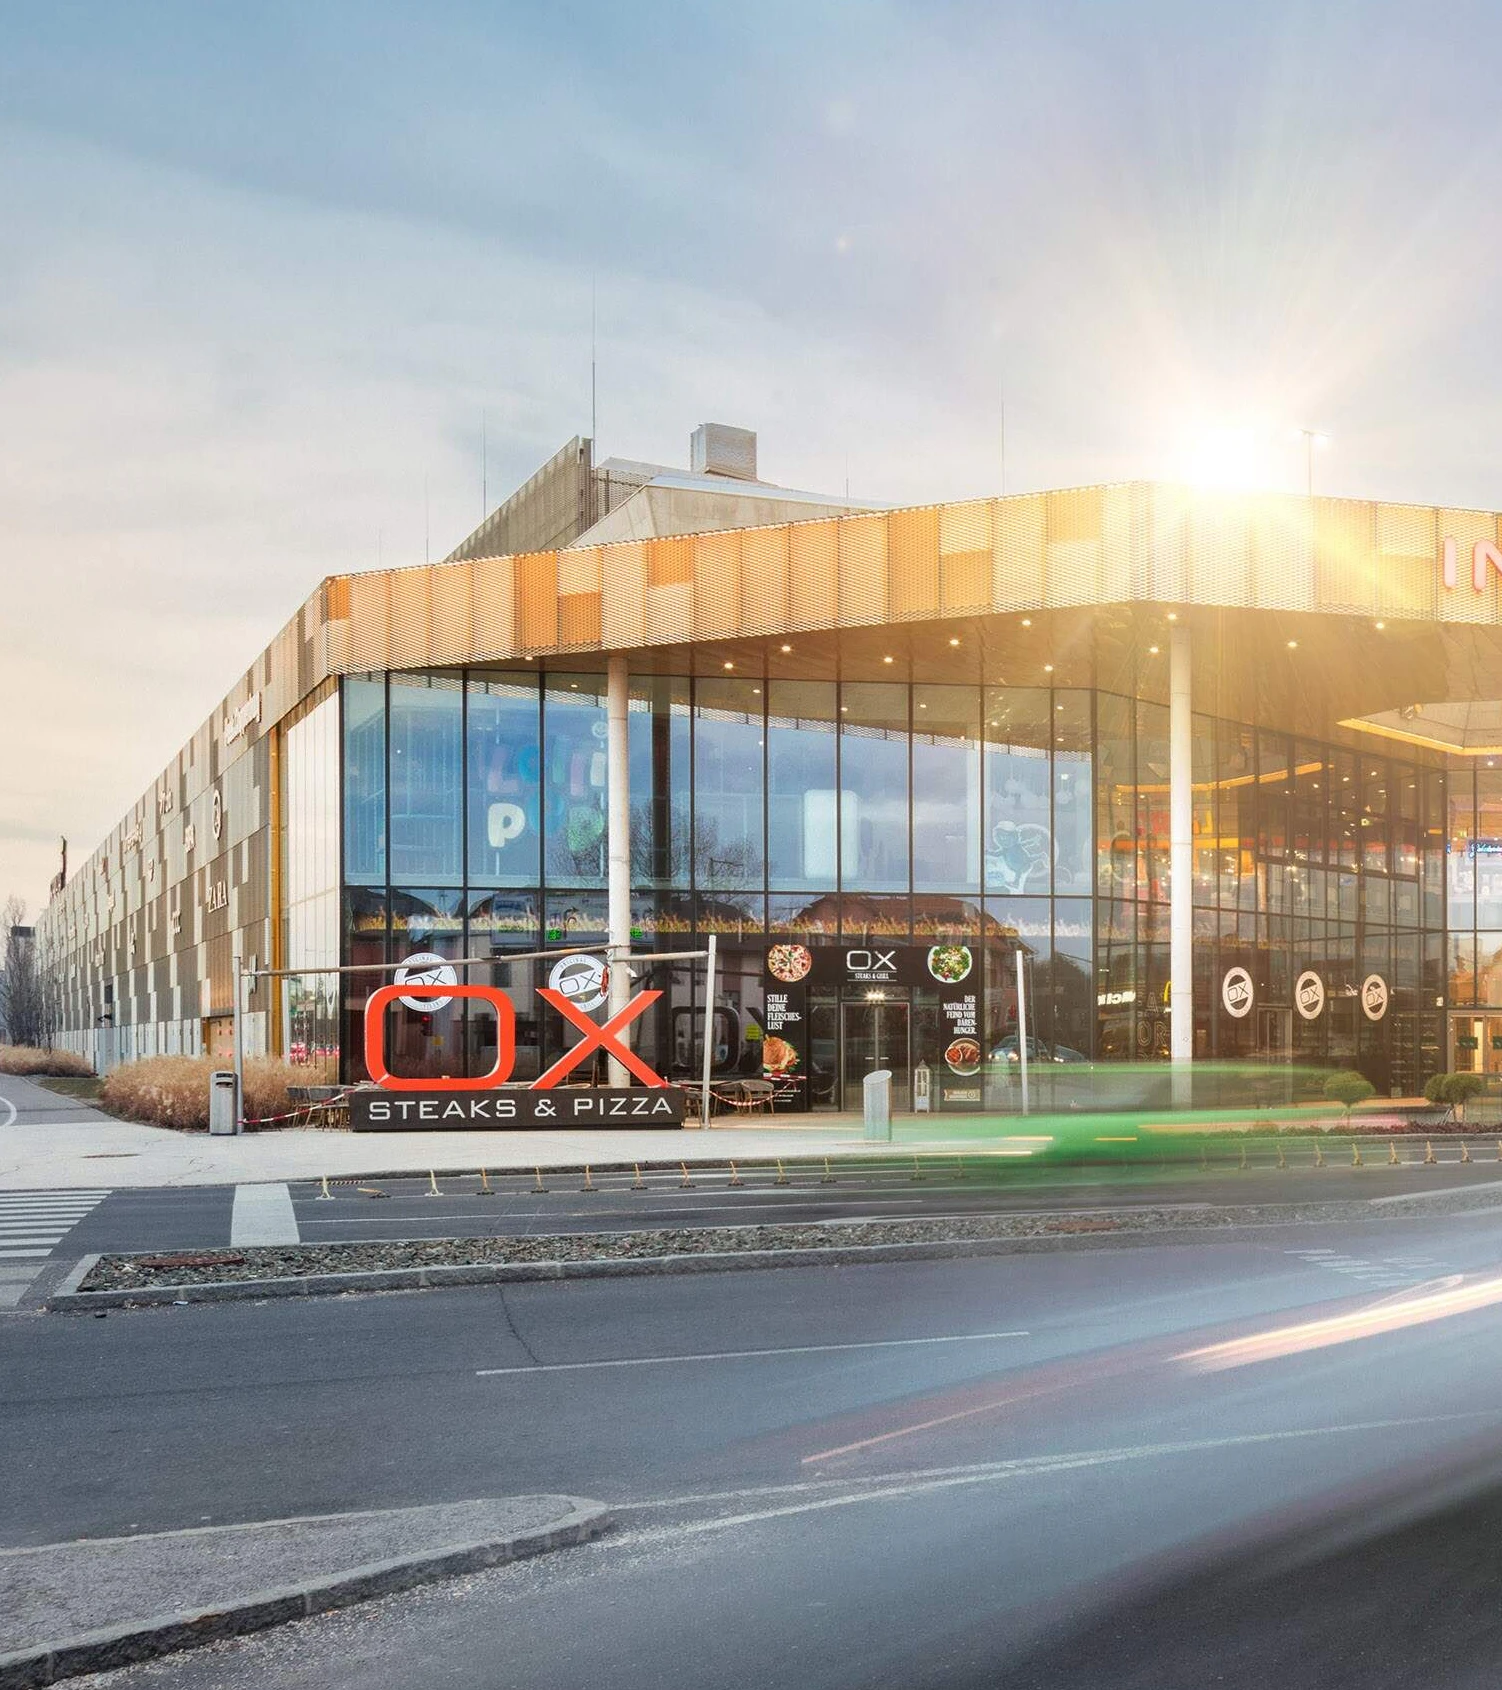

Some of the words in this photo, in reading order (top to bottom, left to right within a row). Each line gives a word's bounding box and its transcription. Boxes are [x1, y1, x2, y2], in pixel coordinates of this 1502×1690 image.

[207, 880, 228, 913] ZARA
[846, 950, 897, 970] OX
[559, 971, 602, 995] OX
[1227, 981, 1250, 1002] OX
[767, 994, 789, 1003] STILLE
[964, 995, 976, 1003] DER
[1300, 985, 1320, 1004] OX
[1366, 989, 1384, 1006] OX
[767, 1003, 787, 1012] DEINE
[767, 1021, 784, 1030] LUST
[364, 984, 667, 1090] OX
[369, 1100, 517, 1120] STEAKS
[534, 1098, 556, 1118] &
[574, 1096, 673, 1116] PIZZA
